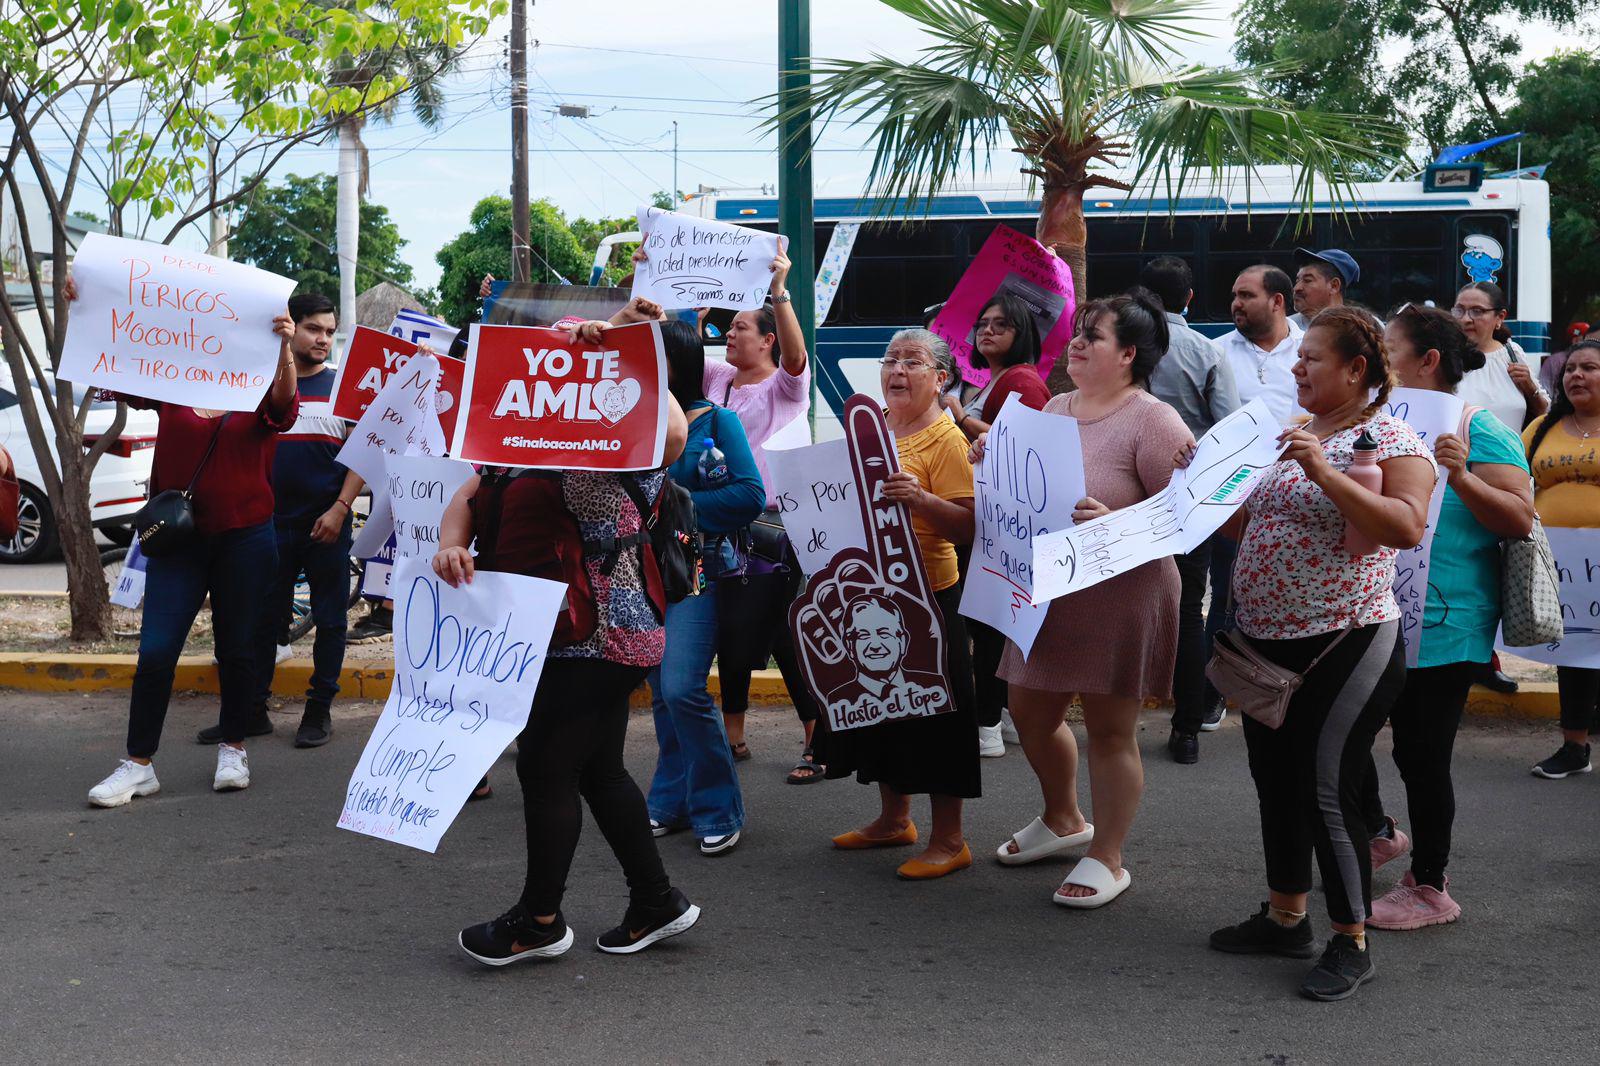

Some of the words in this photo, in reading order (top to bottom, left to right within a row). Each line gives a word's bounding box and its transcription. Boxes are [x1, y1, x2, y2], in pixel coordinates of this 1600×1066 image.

[671, 226, 687, 248] de
[693, 226, 757, 247] bienestar
[163, 255, 219, 275] DESDE
[657, 253, 684, 275] usted
[688, 250, 749, 273] presidente
[92, 352, 122, 374] AL
[131, 358, 179, 379] TIRO
[185, 366, 213, 382] CON
[219, 372, 265, 389] AMLO
[523, 348, 573, 377] YO
[582, 350, 620, 379] TE
[502, 436, 621, 451] #SinaloaconAMLO
[412, 480, 443, 503] con
[812, 481, 852, 512] por
[807, 528, 830, 553] de
[405, 576, 538, 683] Obrador
[397, 674, 454, 726] Usted
[834, 701, 882, 728] Hasta
[886, 693, 906, 713] el
[905, 687, 942, 714] tope
